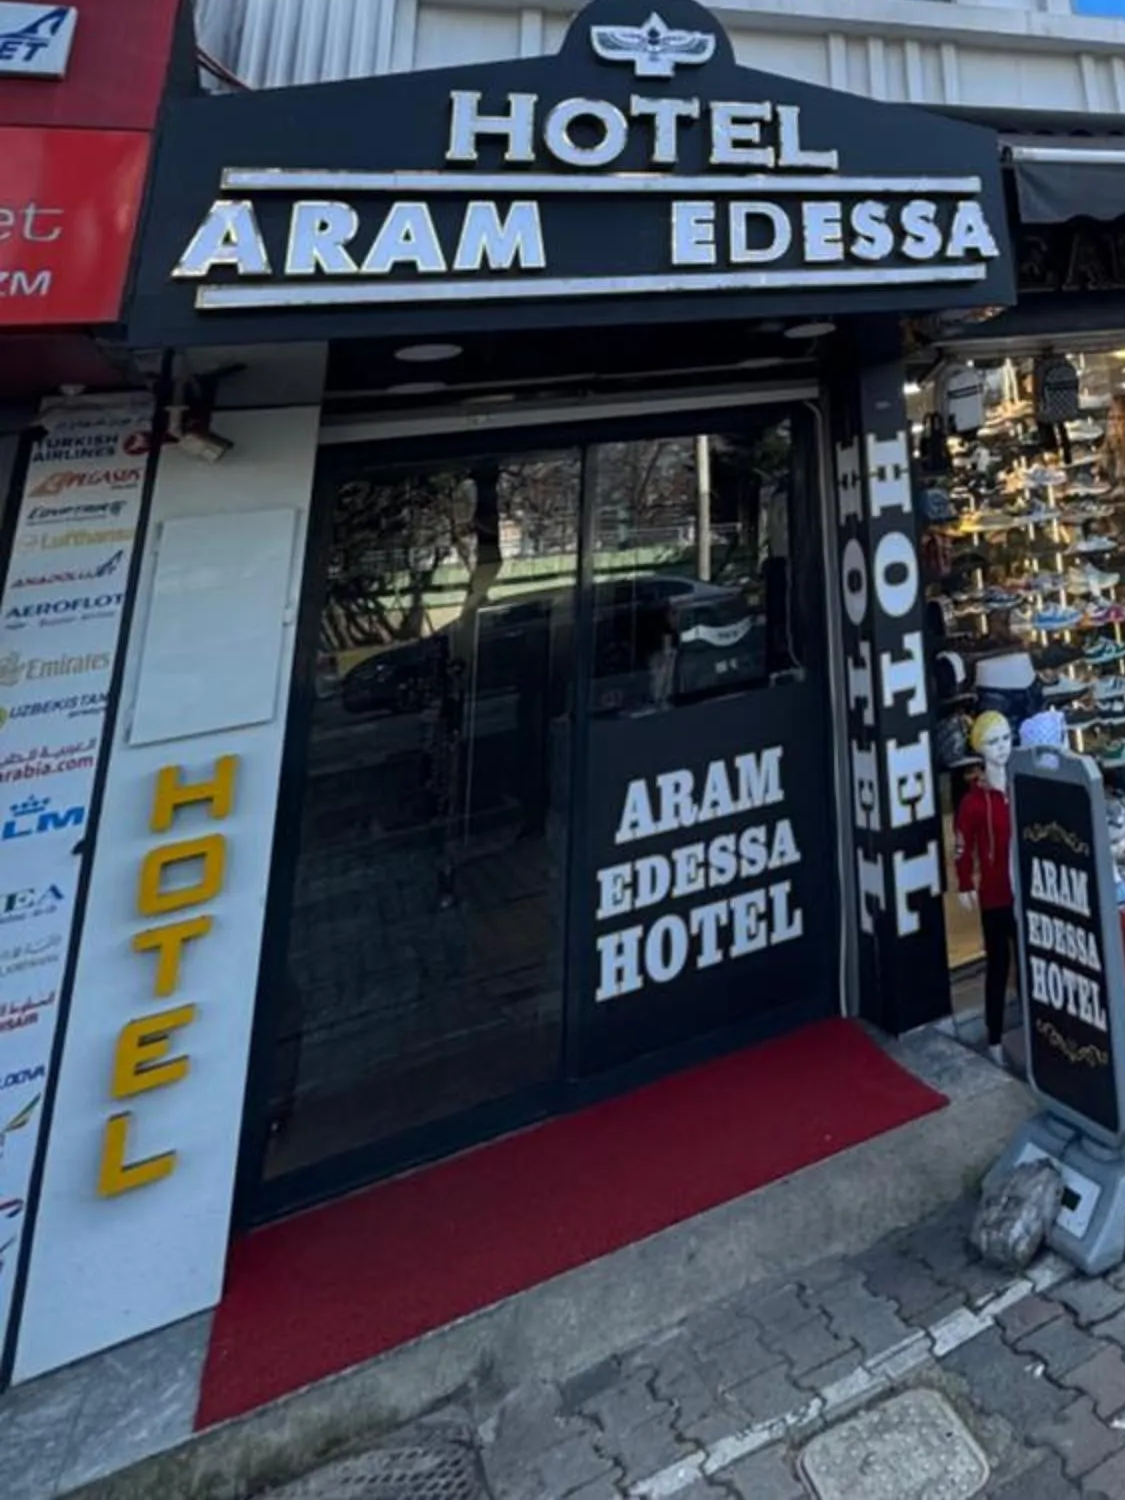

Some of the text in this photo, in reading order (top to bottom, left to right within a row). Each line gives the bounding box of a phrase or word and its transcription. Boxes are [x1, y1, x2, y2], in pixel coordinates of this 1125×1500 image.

[445, 89, 838, 171] HOTEL
[171, 199, 1000, 278] ARAM EDESSA
[5, 593, 124, 619] AEROFLOT
[26, 653, 110, 680] Emirates
[866, 430, 941, 937] HOTEL
[615, 746, 784, 844] ARAM
[596, 819, 801, 920] EDESSA
[1030, 856, 1091, 917] ARAM
[96, 753, 239, 1199] HOTEL
[595, 880, 803, 1002] HOTEL
[1026, 909, 1101, 971] EDESSA
[1029, 955, 1107, 1032] HOTEL
